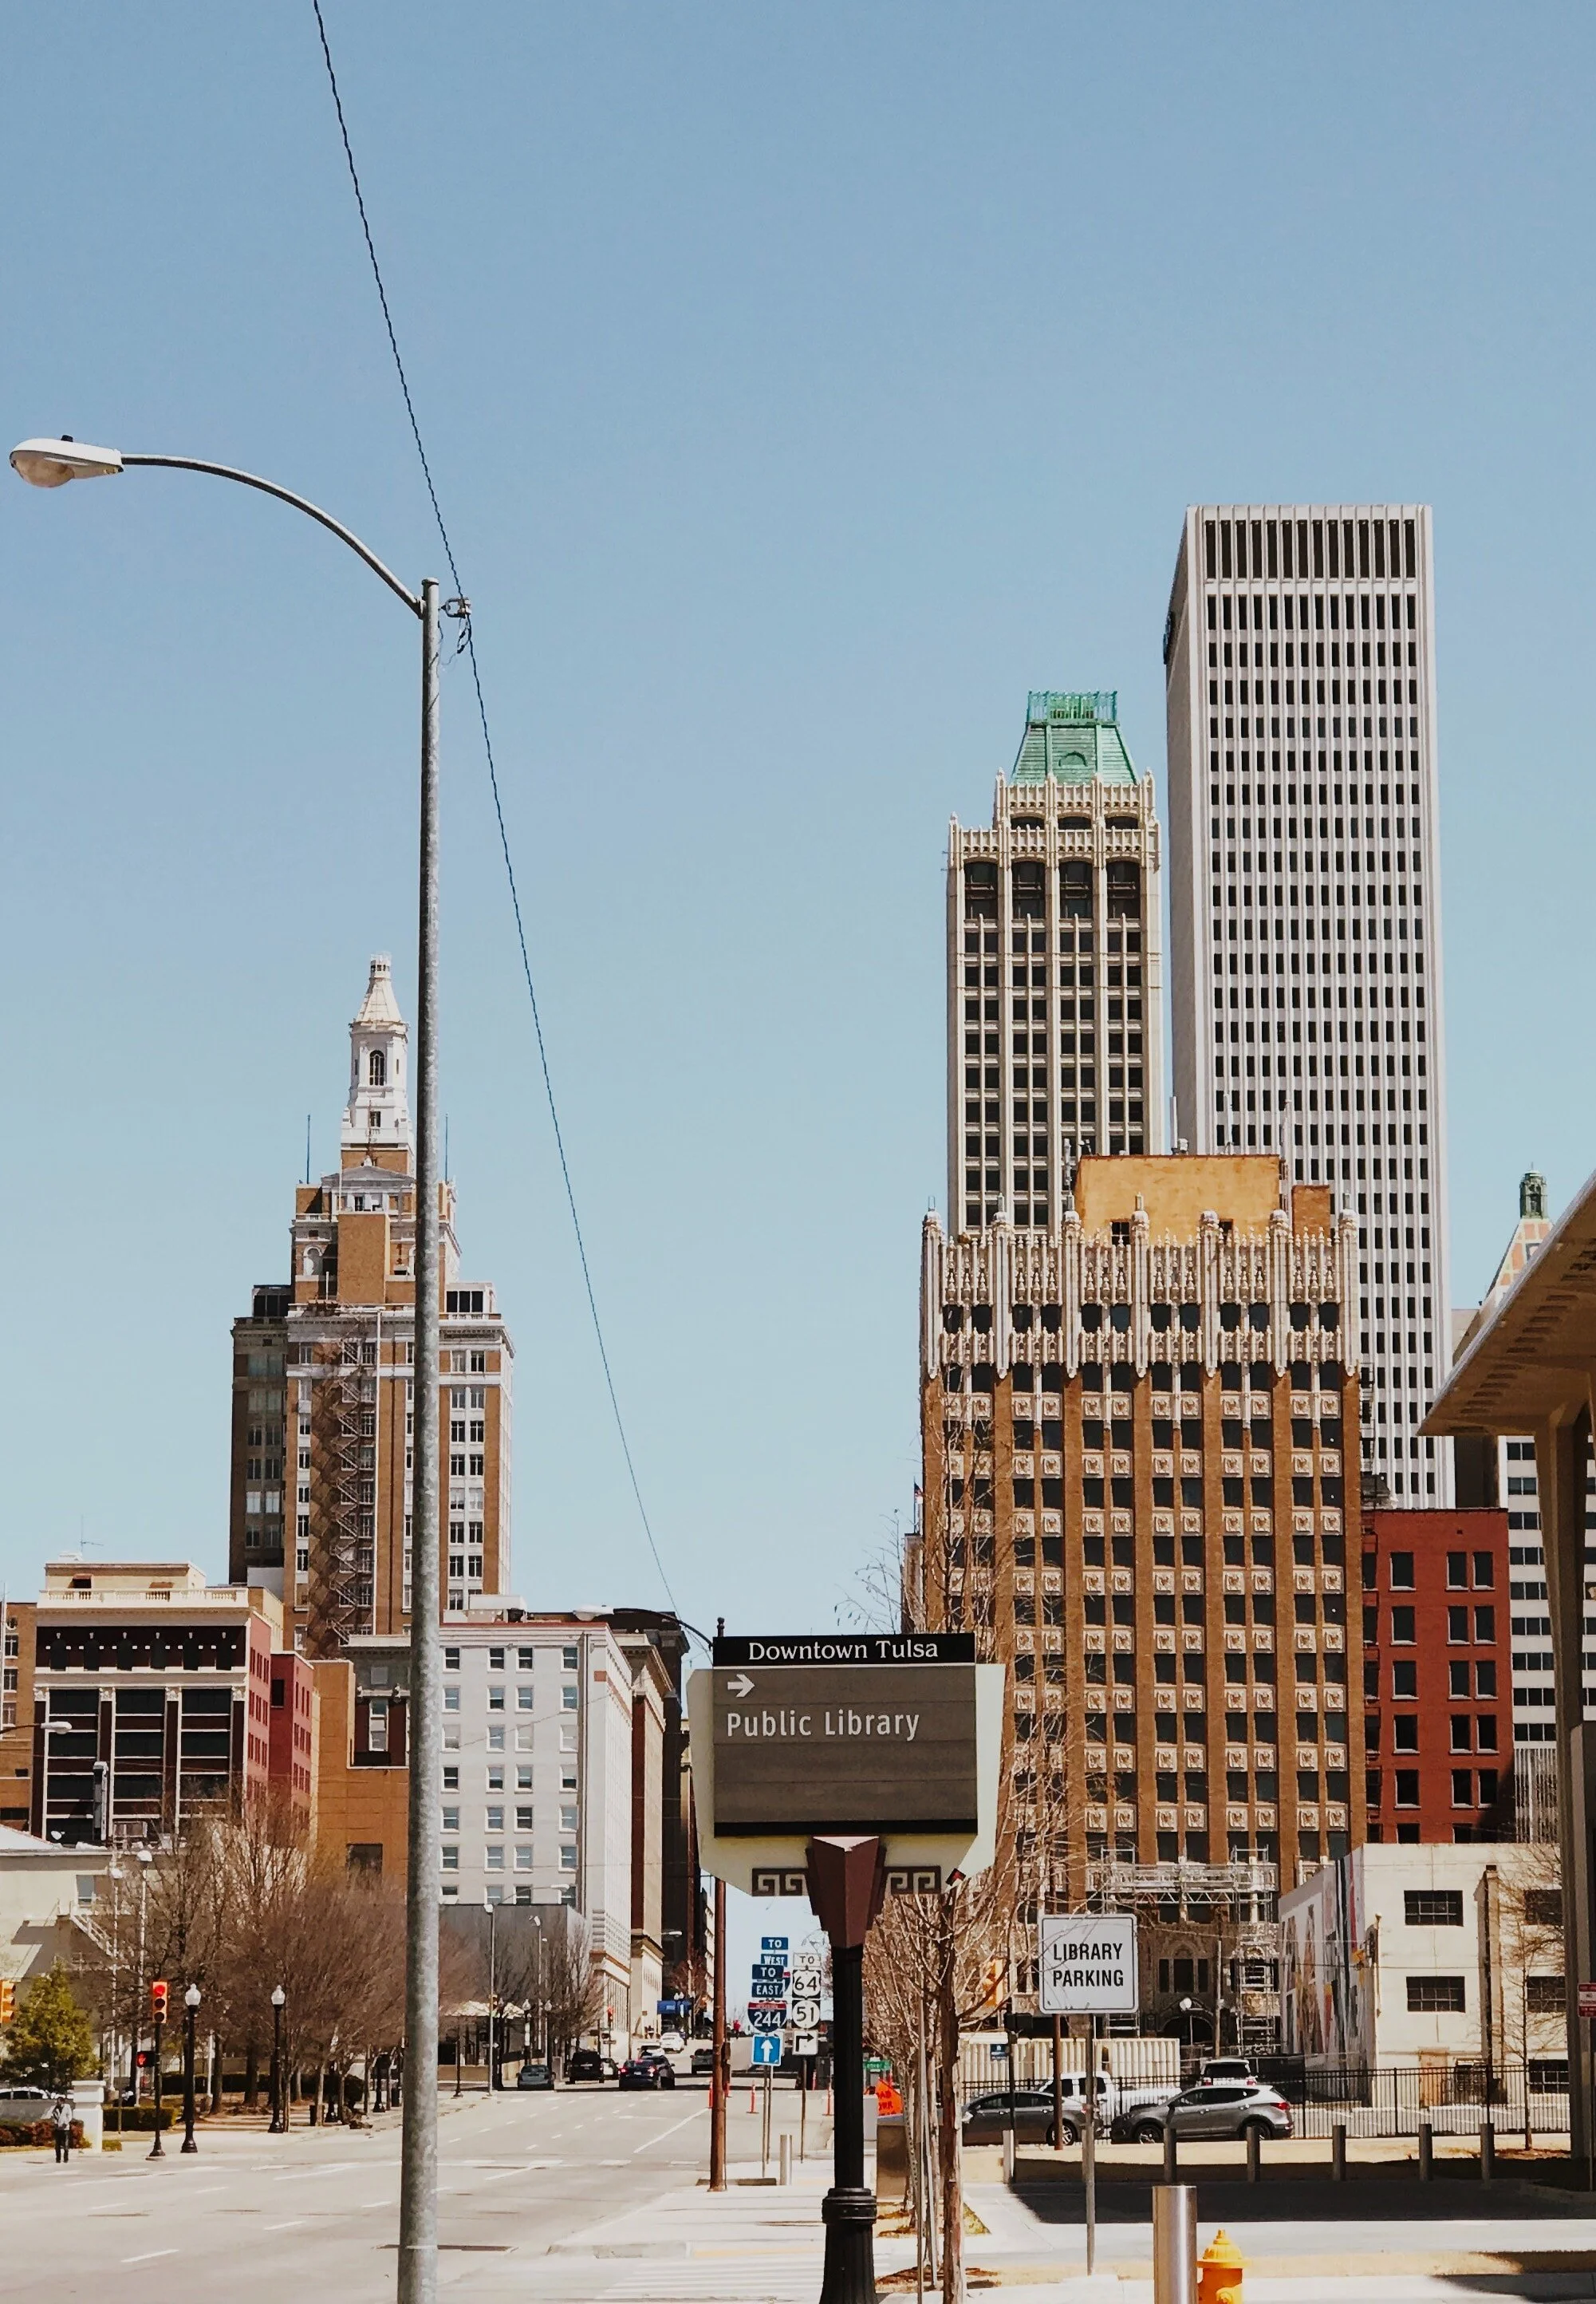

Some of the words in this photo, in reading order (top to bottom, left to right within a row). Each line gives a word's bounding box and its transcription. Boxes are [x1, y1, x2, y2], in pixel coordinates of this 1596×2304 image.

[748, 1640, 868, 1660] Downtown
[875, 1639, 939, 1659] Tulsa
[727, 1710, 812, 1737] Public
[825, 1709, 920, 1742] Library
[768, 1939, 782, 1948] TO
[1054, 1943, 1123, 1960] LIBRARY
[764, 1955, 785, 1965] WEST
[799, 1955, 814, 1964] TO
[760, 1967, 776, 1978] TO
[1053, 1970, 1124, 1987] PARKING
[756, 1985, 779, 1995] EAST
[794, 1975, 818, 1991] 64
[754, 2011, 781, 2028] 244
[796, 2006, 814, 2022] 51
